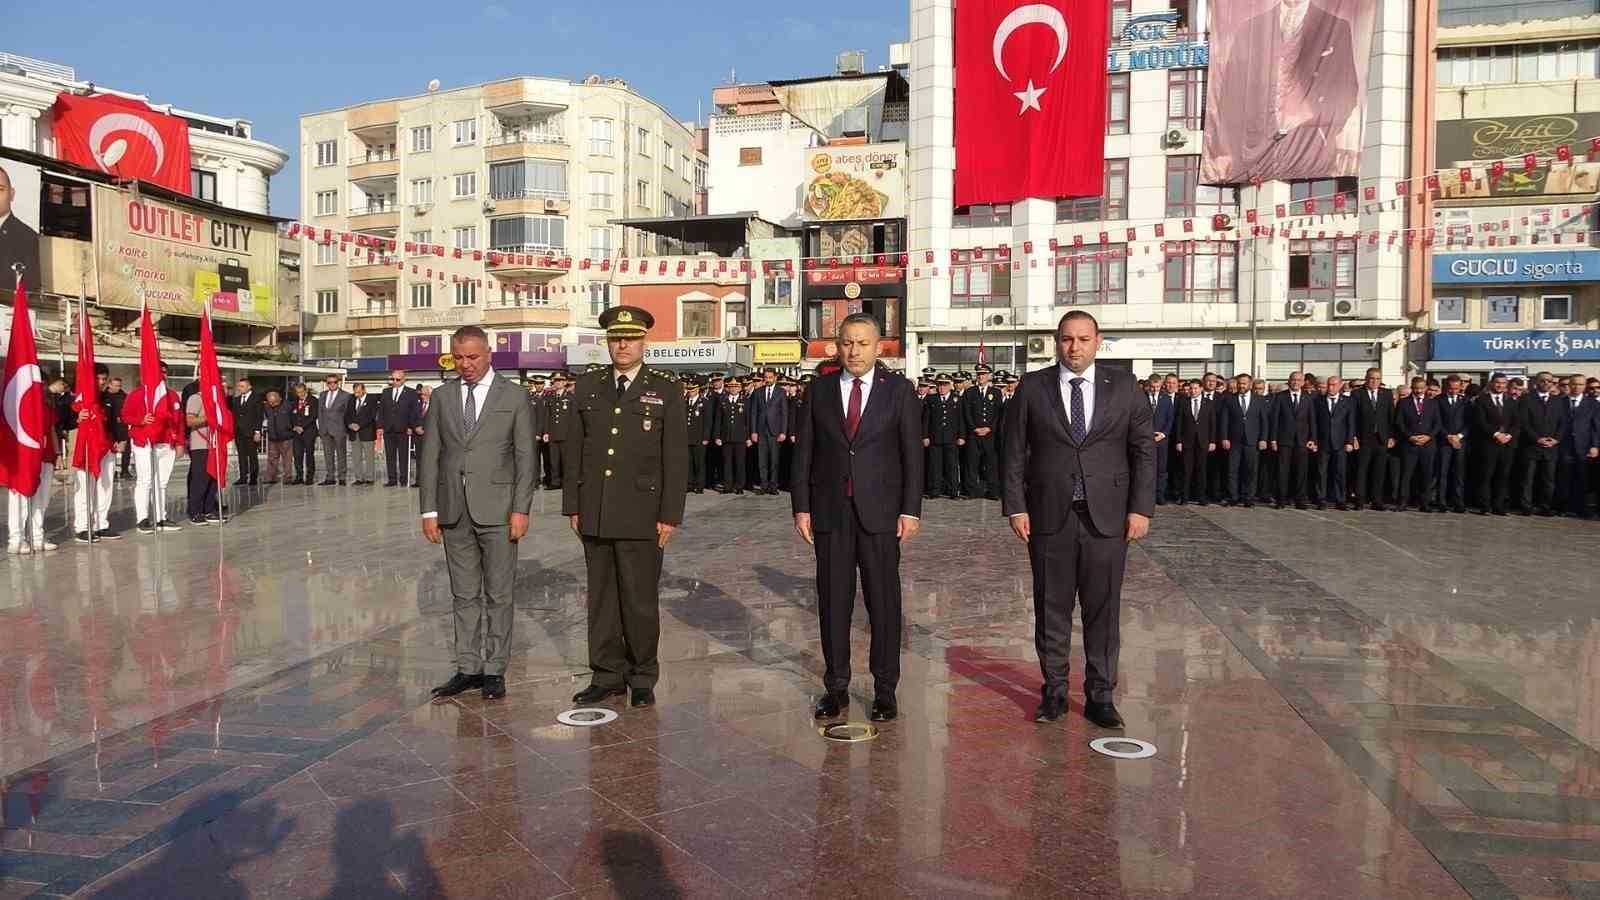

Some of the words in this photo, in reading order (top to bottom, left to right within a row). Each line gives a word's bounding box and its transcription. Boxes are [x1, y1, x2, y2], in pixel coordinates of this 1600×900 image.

[128, 200, 204, 243] OUTLET
[210, 218, 253, 251] CITY
[1523, 261, 1584, 279] sigorta
[1483, 337, 1551, 350] TÜRKİYE
[653, 346, 715, 358] BELEDİYESİ
